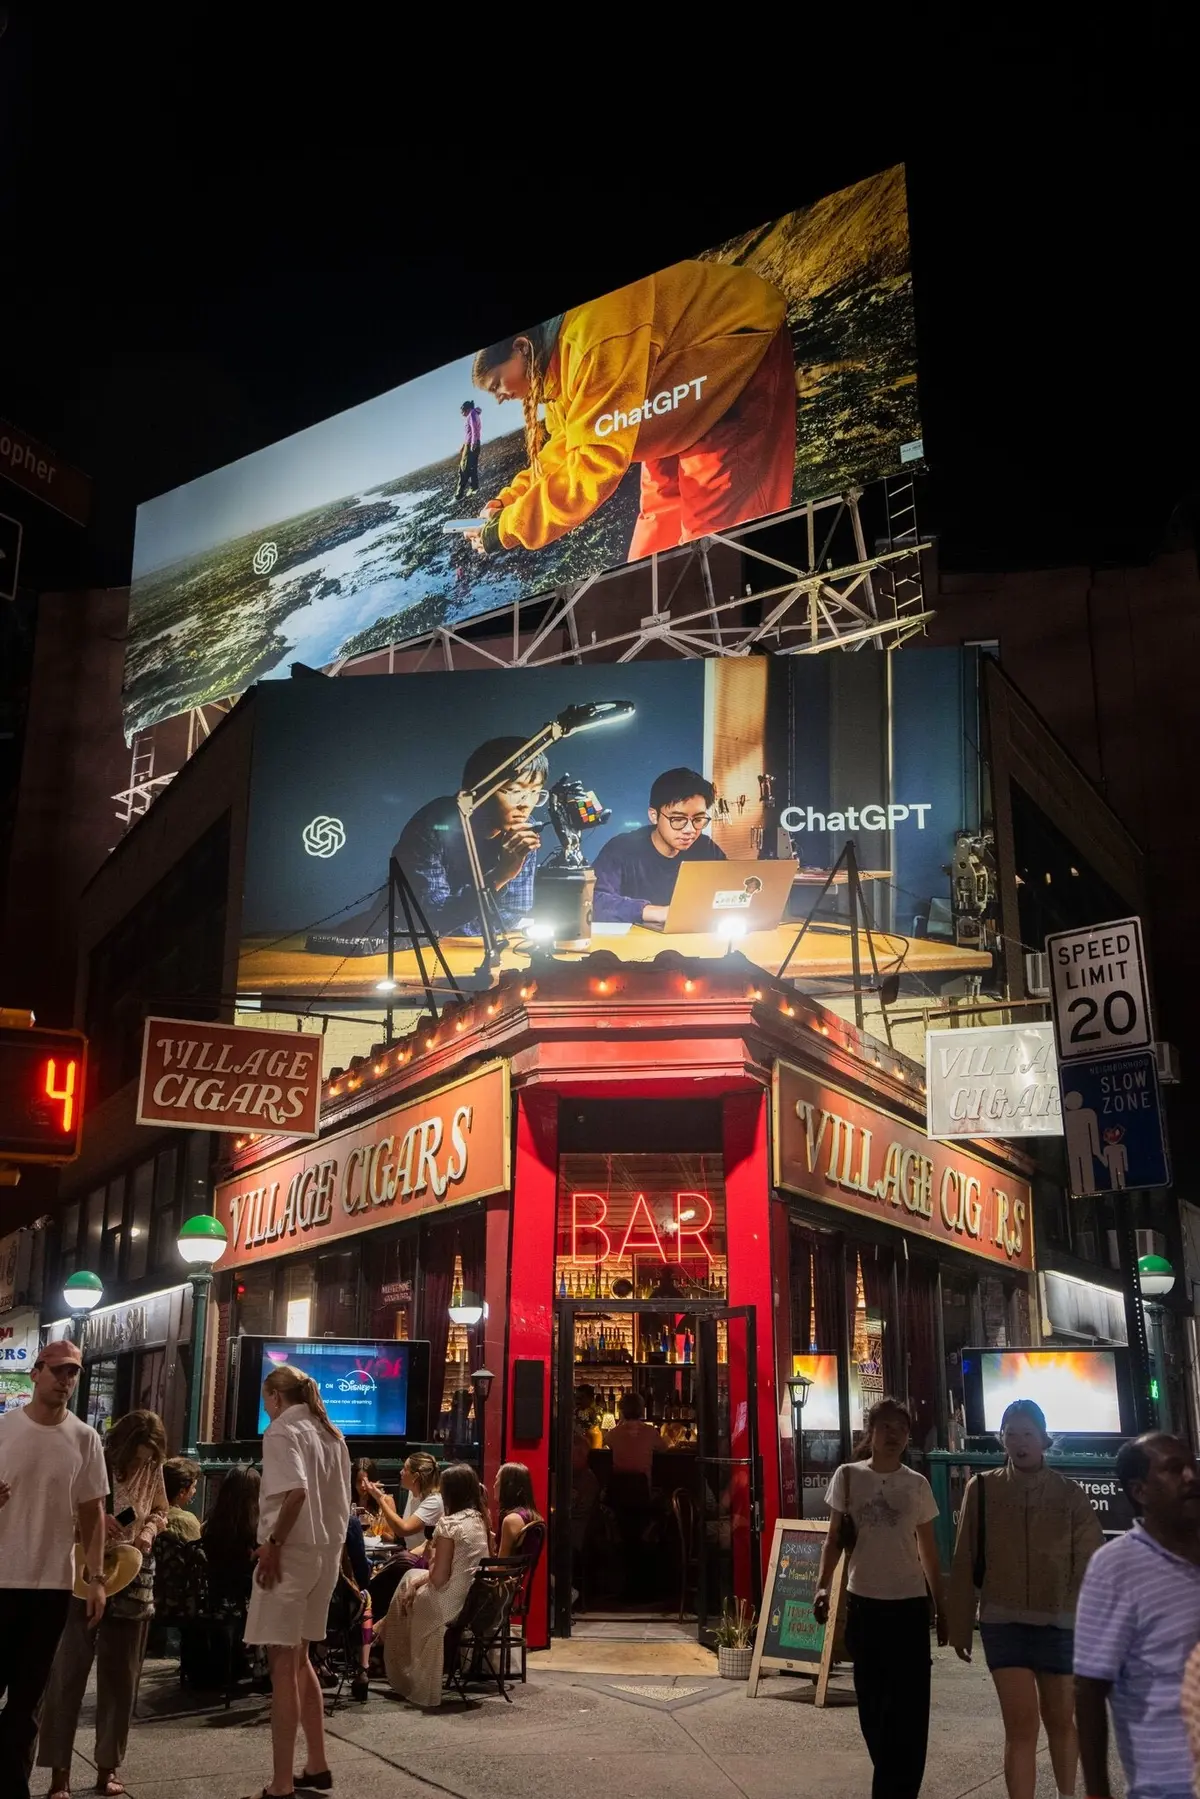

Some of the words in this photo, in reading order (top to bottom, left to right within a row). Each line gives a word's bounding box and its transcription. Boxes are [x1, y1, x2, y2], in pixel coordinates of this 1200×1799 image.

[594, 375, 707, 437] ChatGPT
[0, 436, 57, 484] opher
[780, 804, 931, 832] ChatGPT
[1058, 935, 1131, 965] SPEED
[1066, 961, 1127, 990] LIMIT
[1068, 990, 1137, 1043] 20
[156, 1038, 313, 1080] VILLAGE
[939, 1041, 1057, 1079] VILLA
[45, 1058, 76, 1132] 4
[152, 1073, 309, 1124] CIGARS
[1100, 1070, 1147, 1094] SLOW
[1102, 1091, 1151, 1114] ZONE
[230, 1160, 336, 1251] VILLAGE
[342, 1106, 473, 1214] CIGARS
[796, 1099, 934, 1217] VILLAGE
[573, 1194, 714, 1263] BAR
[337, 1377, 377, 1396] Disney+
[1073, 1480, 1123, 1495] treet-
